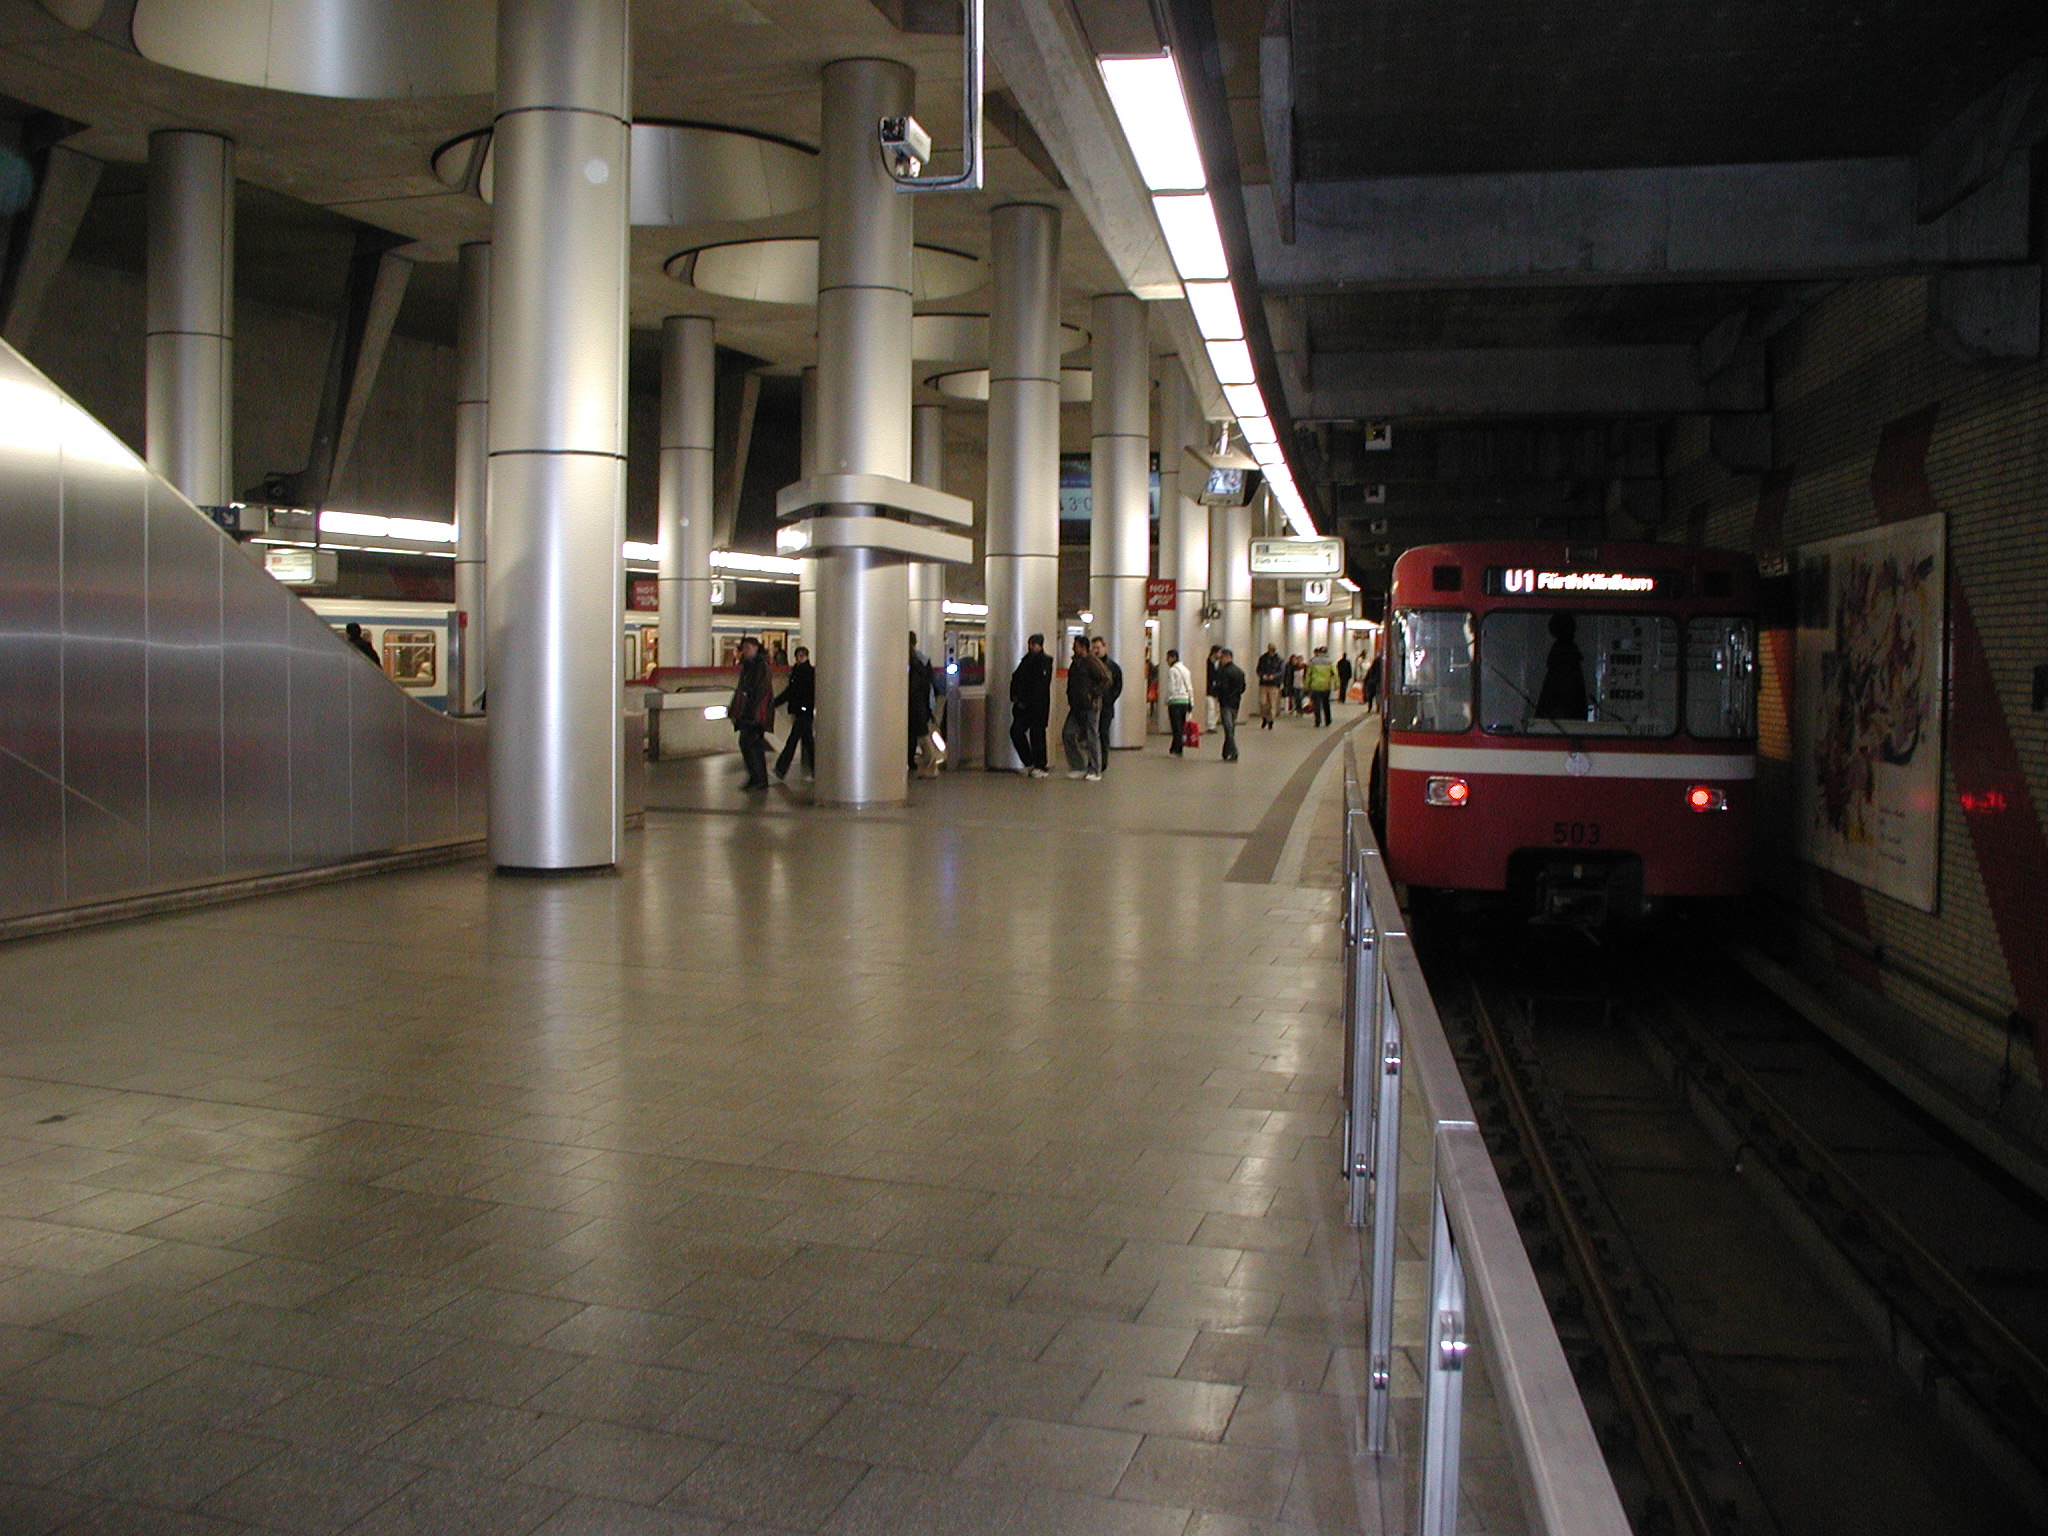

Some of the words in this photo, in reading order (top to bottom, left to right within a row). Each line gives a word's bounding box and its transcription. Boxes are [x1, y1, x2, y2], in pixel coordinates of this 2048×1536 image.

[1505, 569, 1534, 592] U1
[1537, 573, 1582, 591] Fürth
[1583, 574, 1654, 591] Klinikum
[1553, 822, 1601, 844] 503
